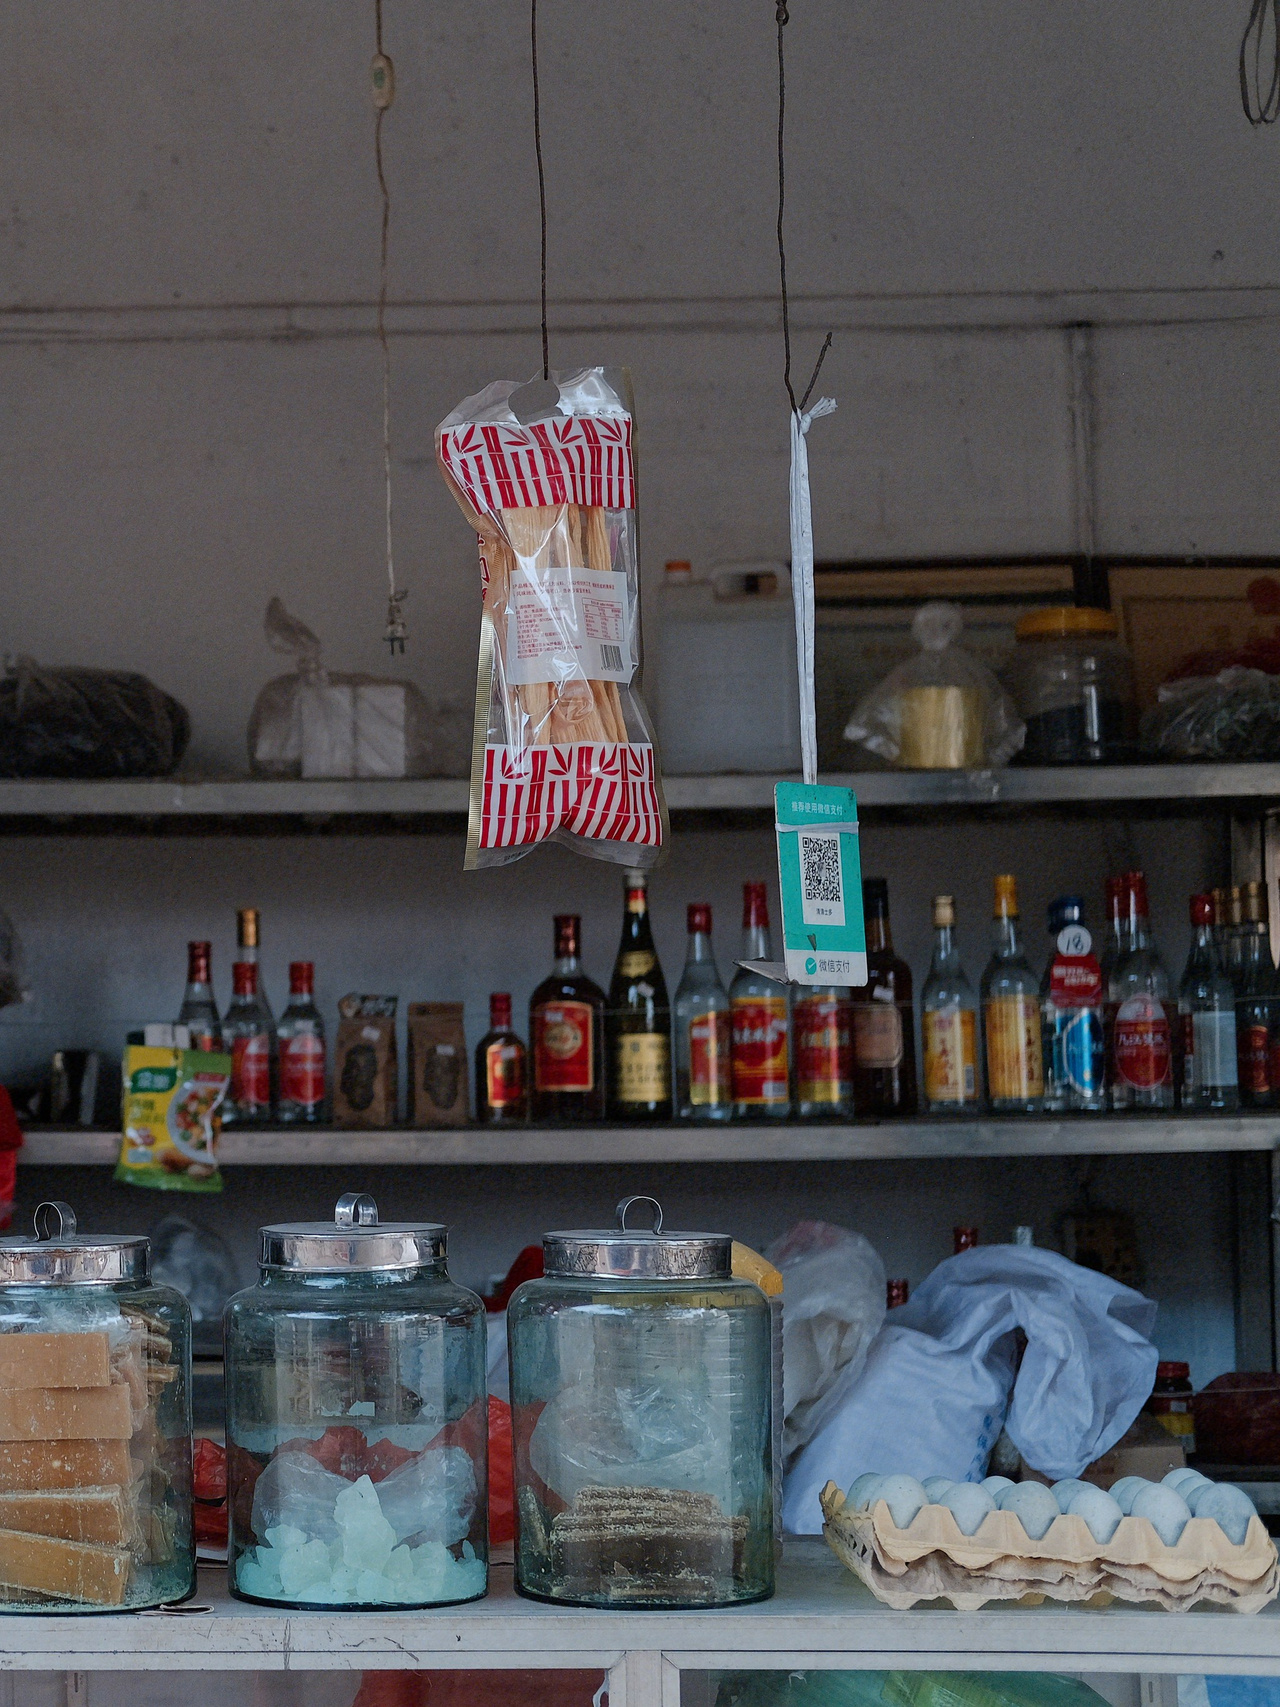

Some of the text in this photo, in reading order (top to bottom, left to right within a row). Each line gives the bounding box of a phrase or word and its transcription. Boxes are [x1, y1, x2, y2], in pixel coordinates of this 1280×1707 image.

[791, 801, 843, 816] 推荐使用微信支付
[819, 960, 850, 974] 微信支付
